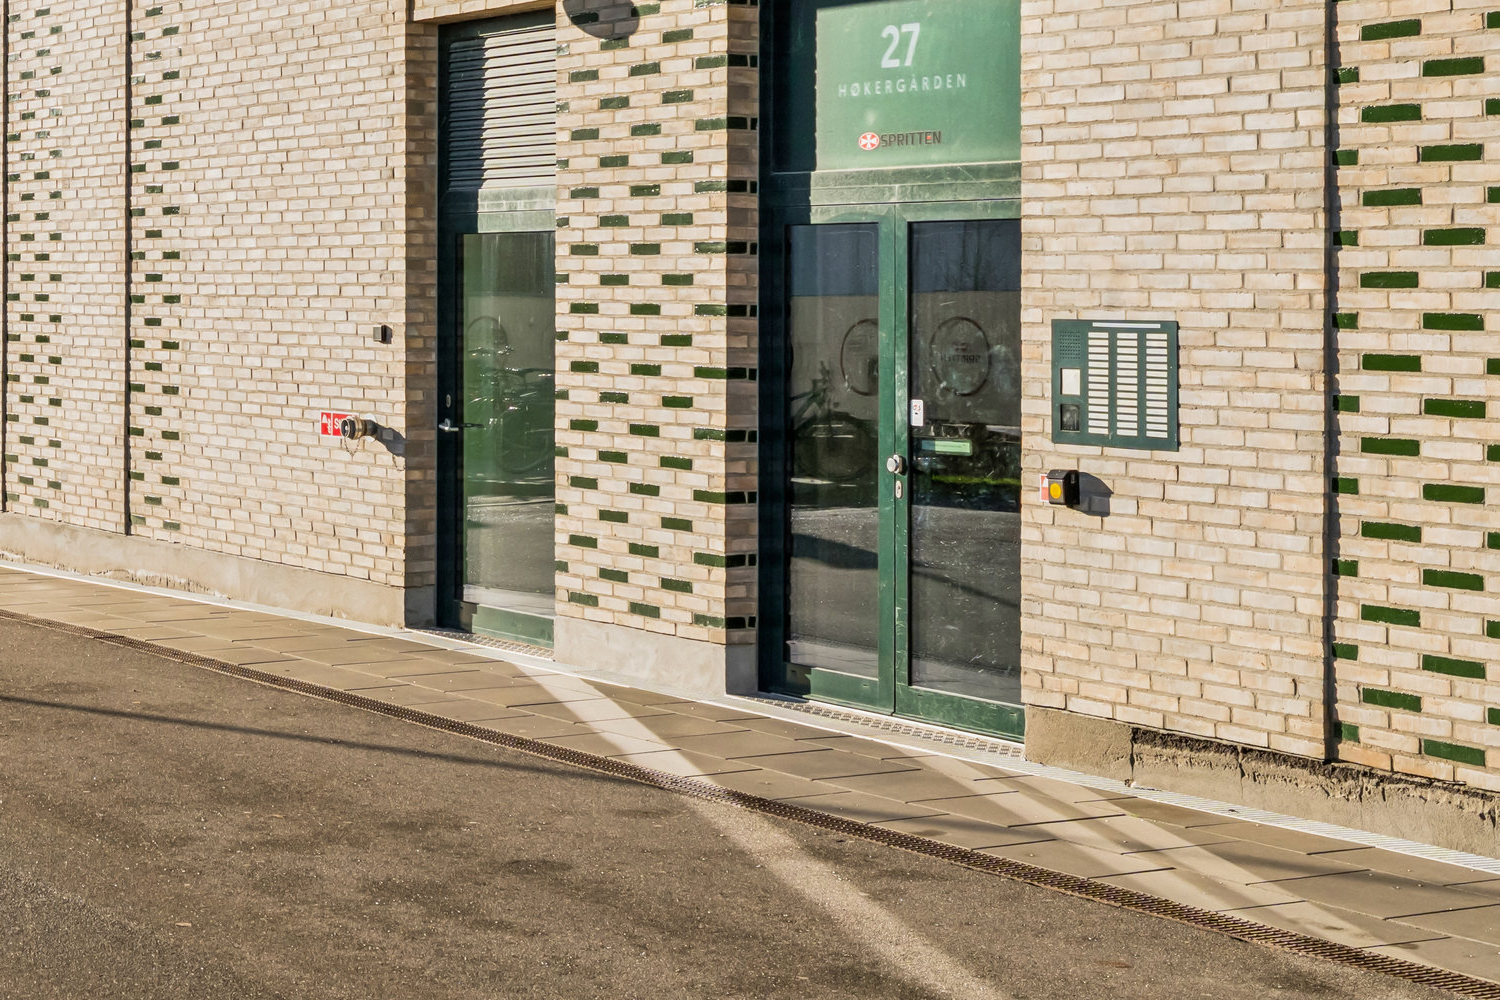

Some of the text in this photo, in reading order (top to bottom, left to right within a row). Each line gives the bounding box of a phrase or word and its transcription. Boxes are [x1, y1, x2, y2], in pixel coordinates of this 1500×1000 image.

[881, 22, 921, 68] 27
[838, 73, 967, 98] HØKERGÅRDEN
[879, 130, 943, 148] SPRITTEN
